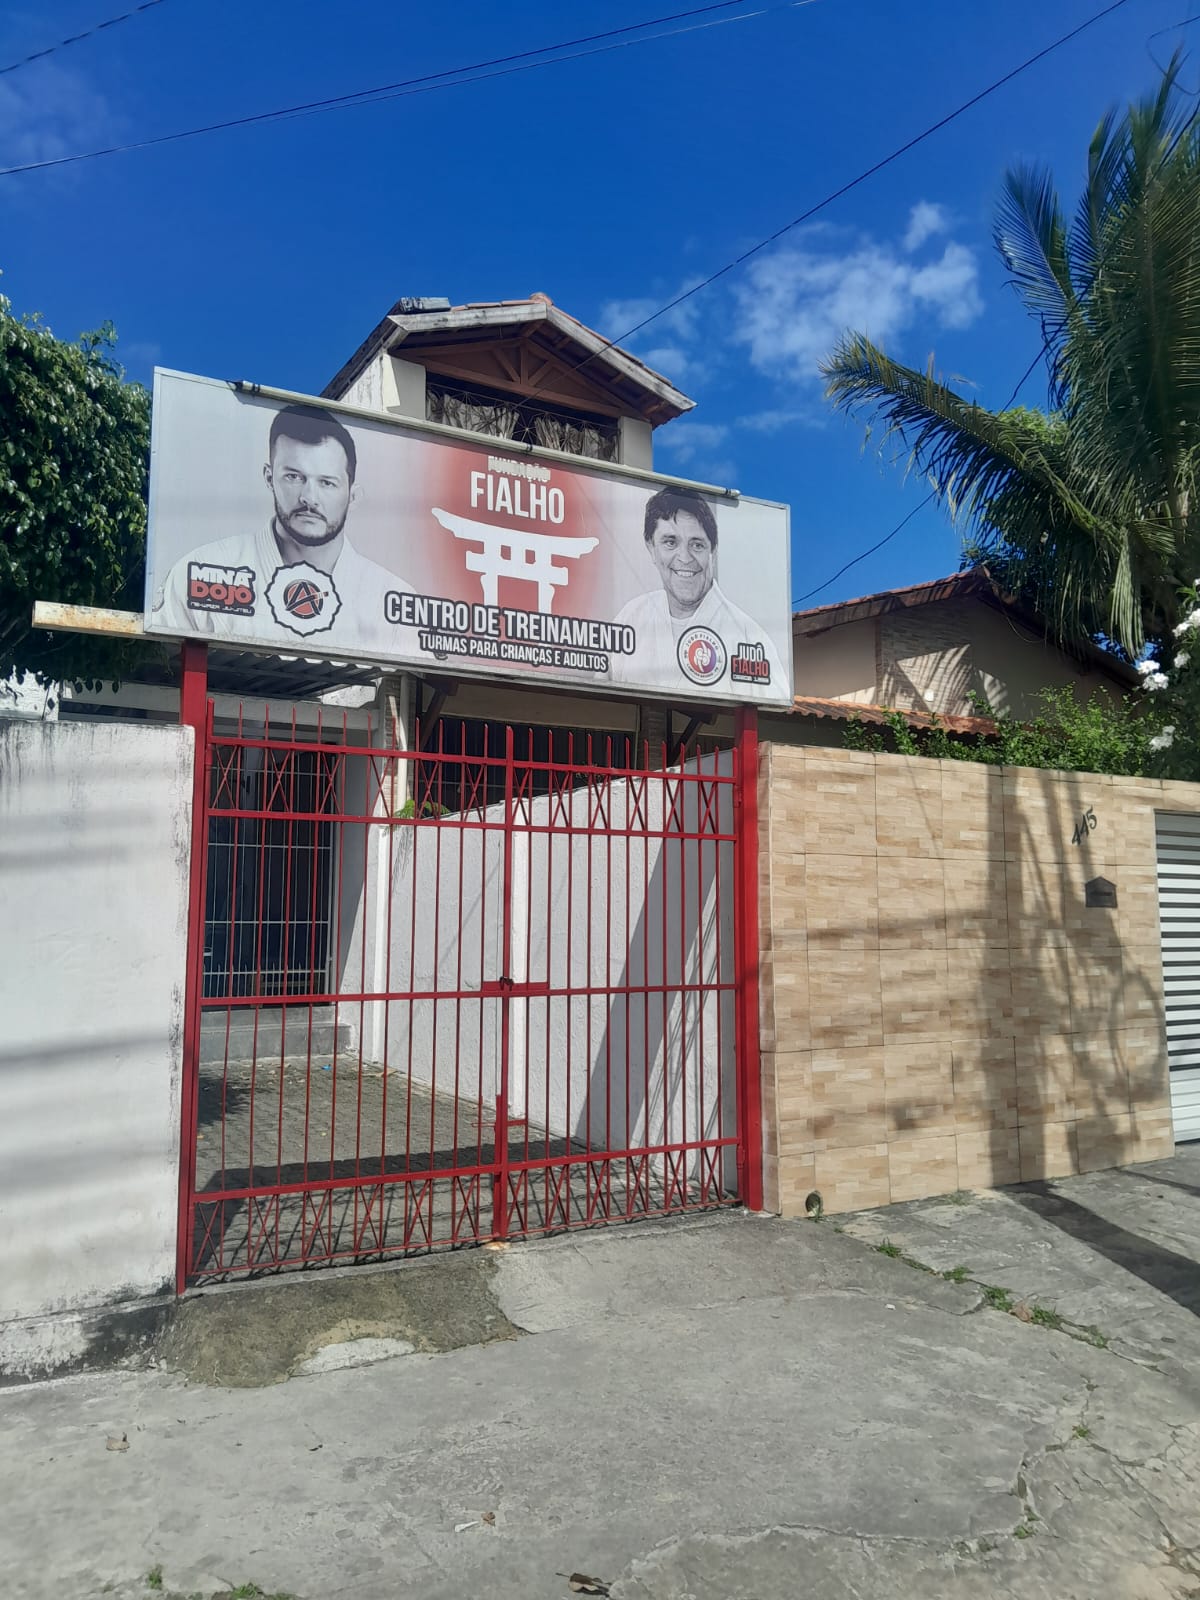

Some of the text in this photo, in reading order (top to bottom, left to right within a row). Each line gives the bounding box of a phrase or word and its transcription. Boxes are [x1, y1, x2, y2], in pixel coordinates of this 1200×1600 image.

[470, 470, 565, 524] FIALHO
[191, 580, 252, 605] DOJO
[386, 592, 635, 654] CENTRO DE TREINAMENTO
[419, 632, 608, 671] TURMAS PARA CRIANÇAS E ADULTOS
[733, 656, 768, 677] FIALHO
[1071, 804, 1097, 845] 445
